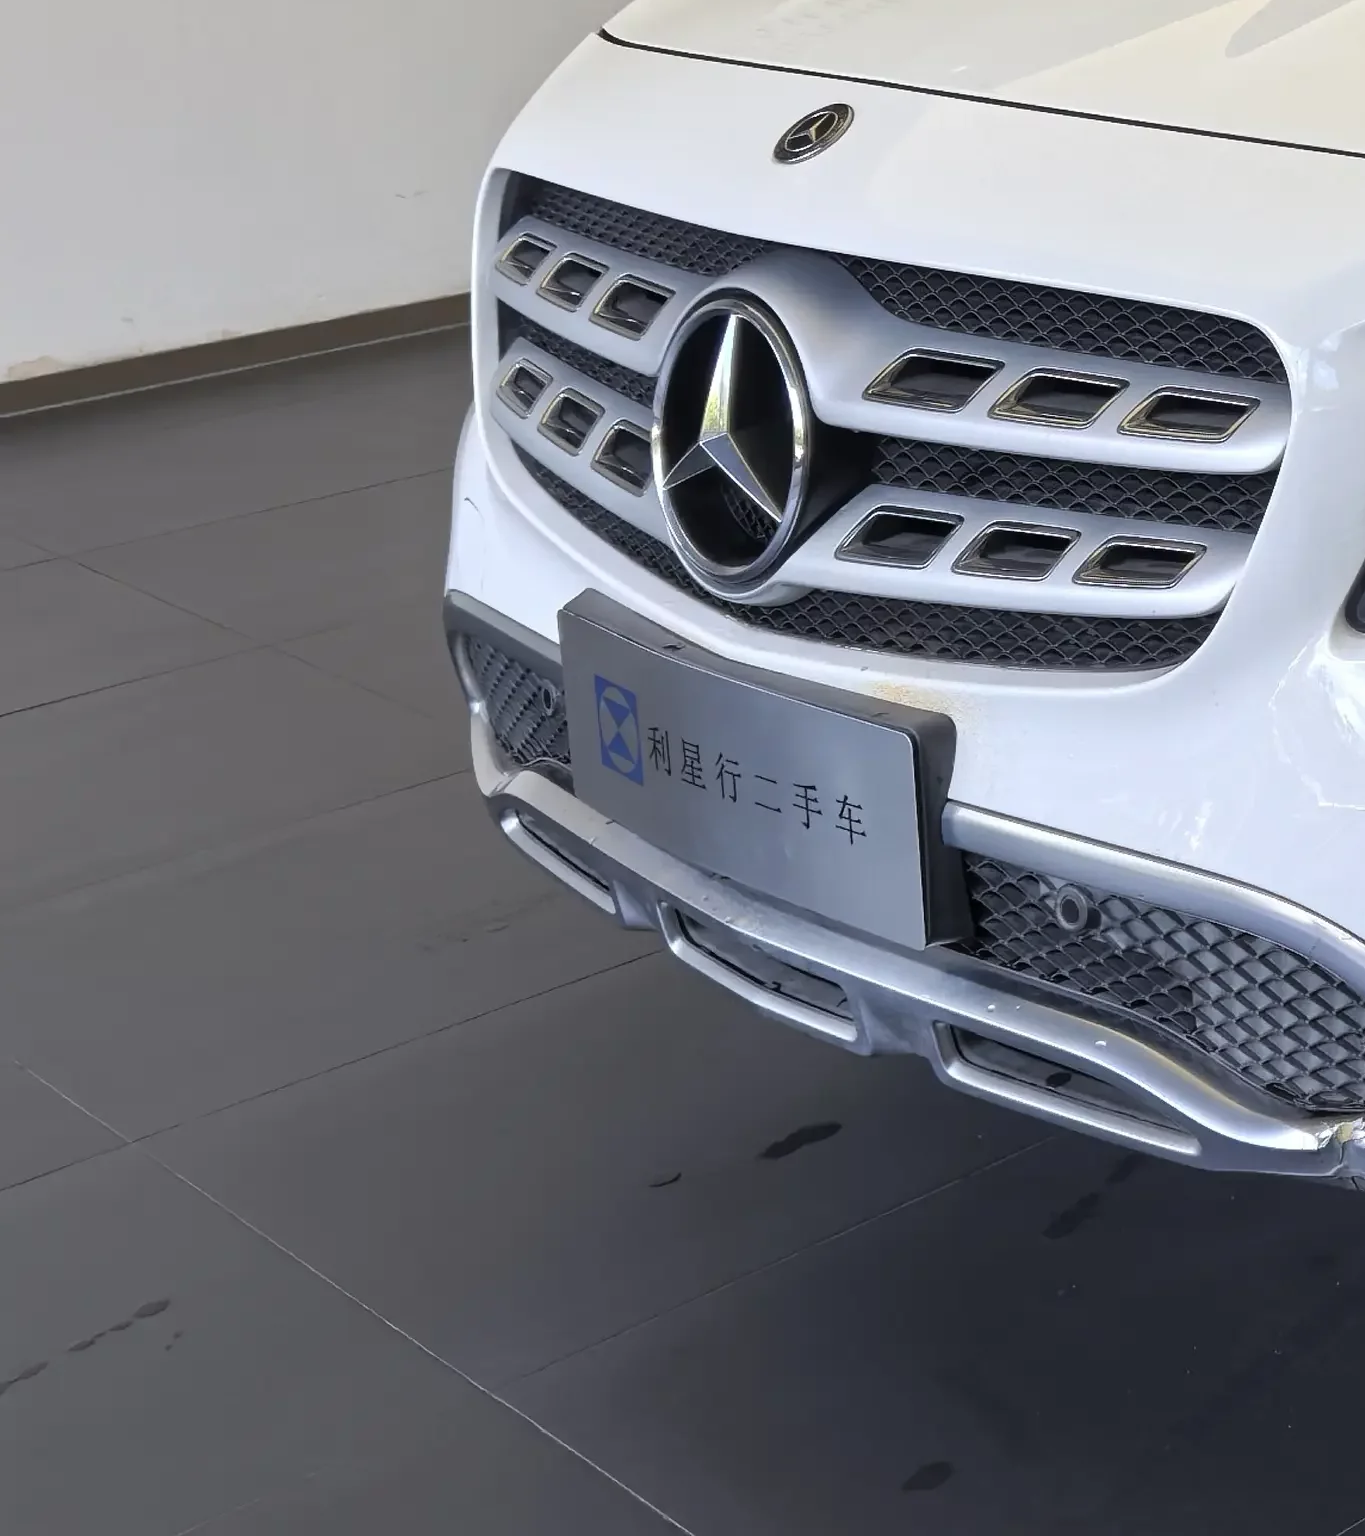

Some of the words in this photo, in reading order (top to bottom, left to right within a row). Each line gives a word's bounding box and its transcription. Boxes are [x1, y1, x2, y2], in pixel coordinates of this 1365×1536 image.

[647, 726, 867, 846] 利星行二手车
